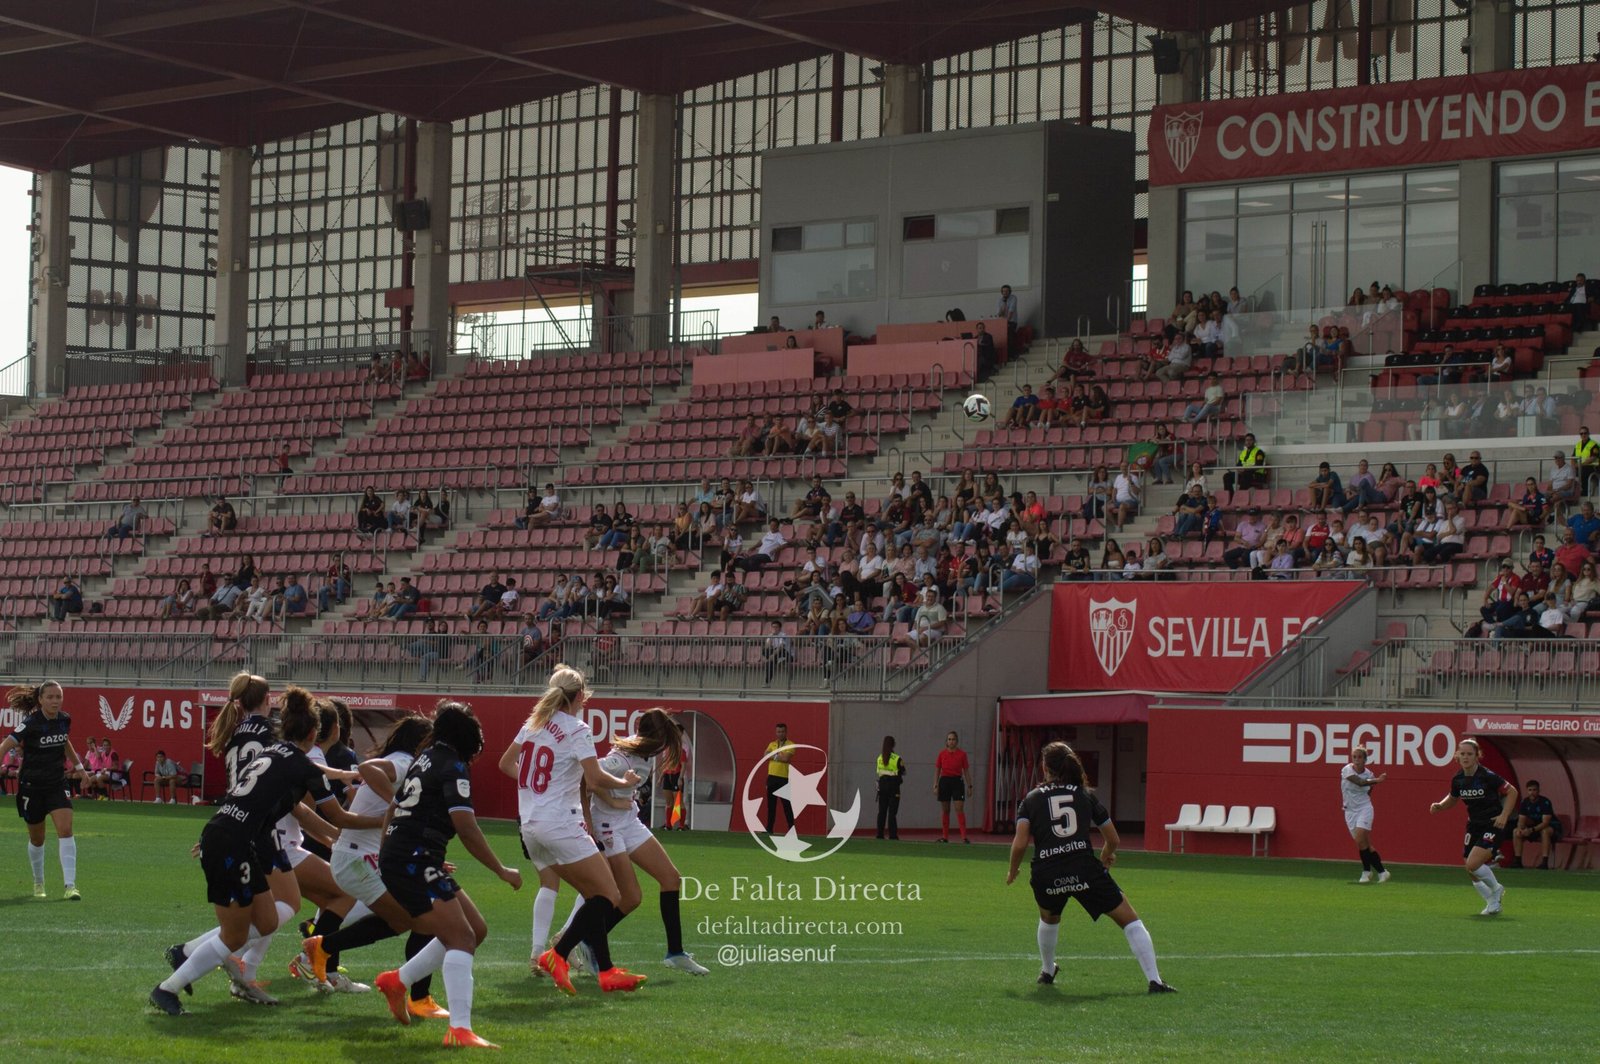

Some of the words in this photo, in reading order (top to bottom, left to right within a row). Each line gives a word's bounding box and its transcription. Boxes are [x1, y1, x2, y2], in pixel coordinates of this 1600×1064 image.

[1216, 84, 1567, 160] CONSTRUYENDO
[1147, 616, 1272, 658] SEVILLA
[1296, 722, 1457, 767] DEGIRO
[1487, 721, 1519, 730] Valvoline
[1537, 719, 1580, 731] DEGIRO
[1583, 720, 1600, 731] Cru
[232, 757, 273, 797] 3
[518, 741, 555, 795] 18
[22, 796, 30, 811] 7
[1048, 795, 1078, 838] 5
[1039, 841, 1087, 859] euskaltel
[239, 861, 251, 885] 3
